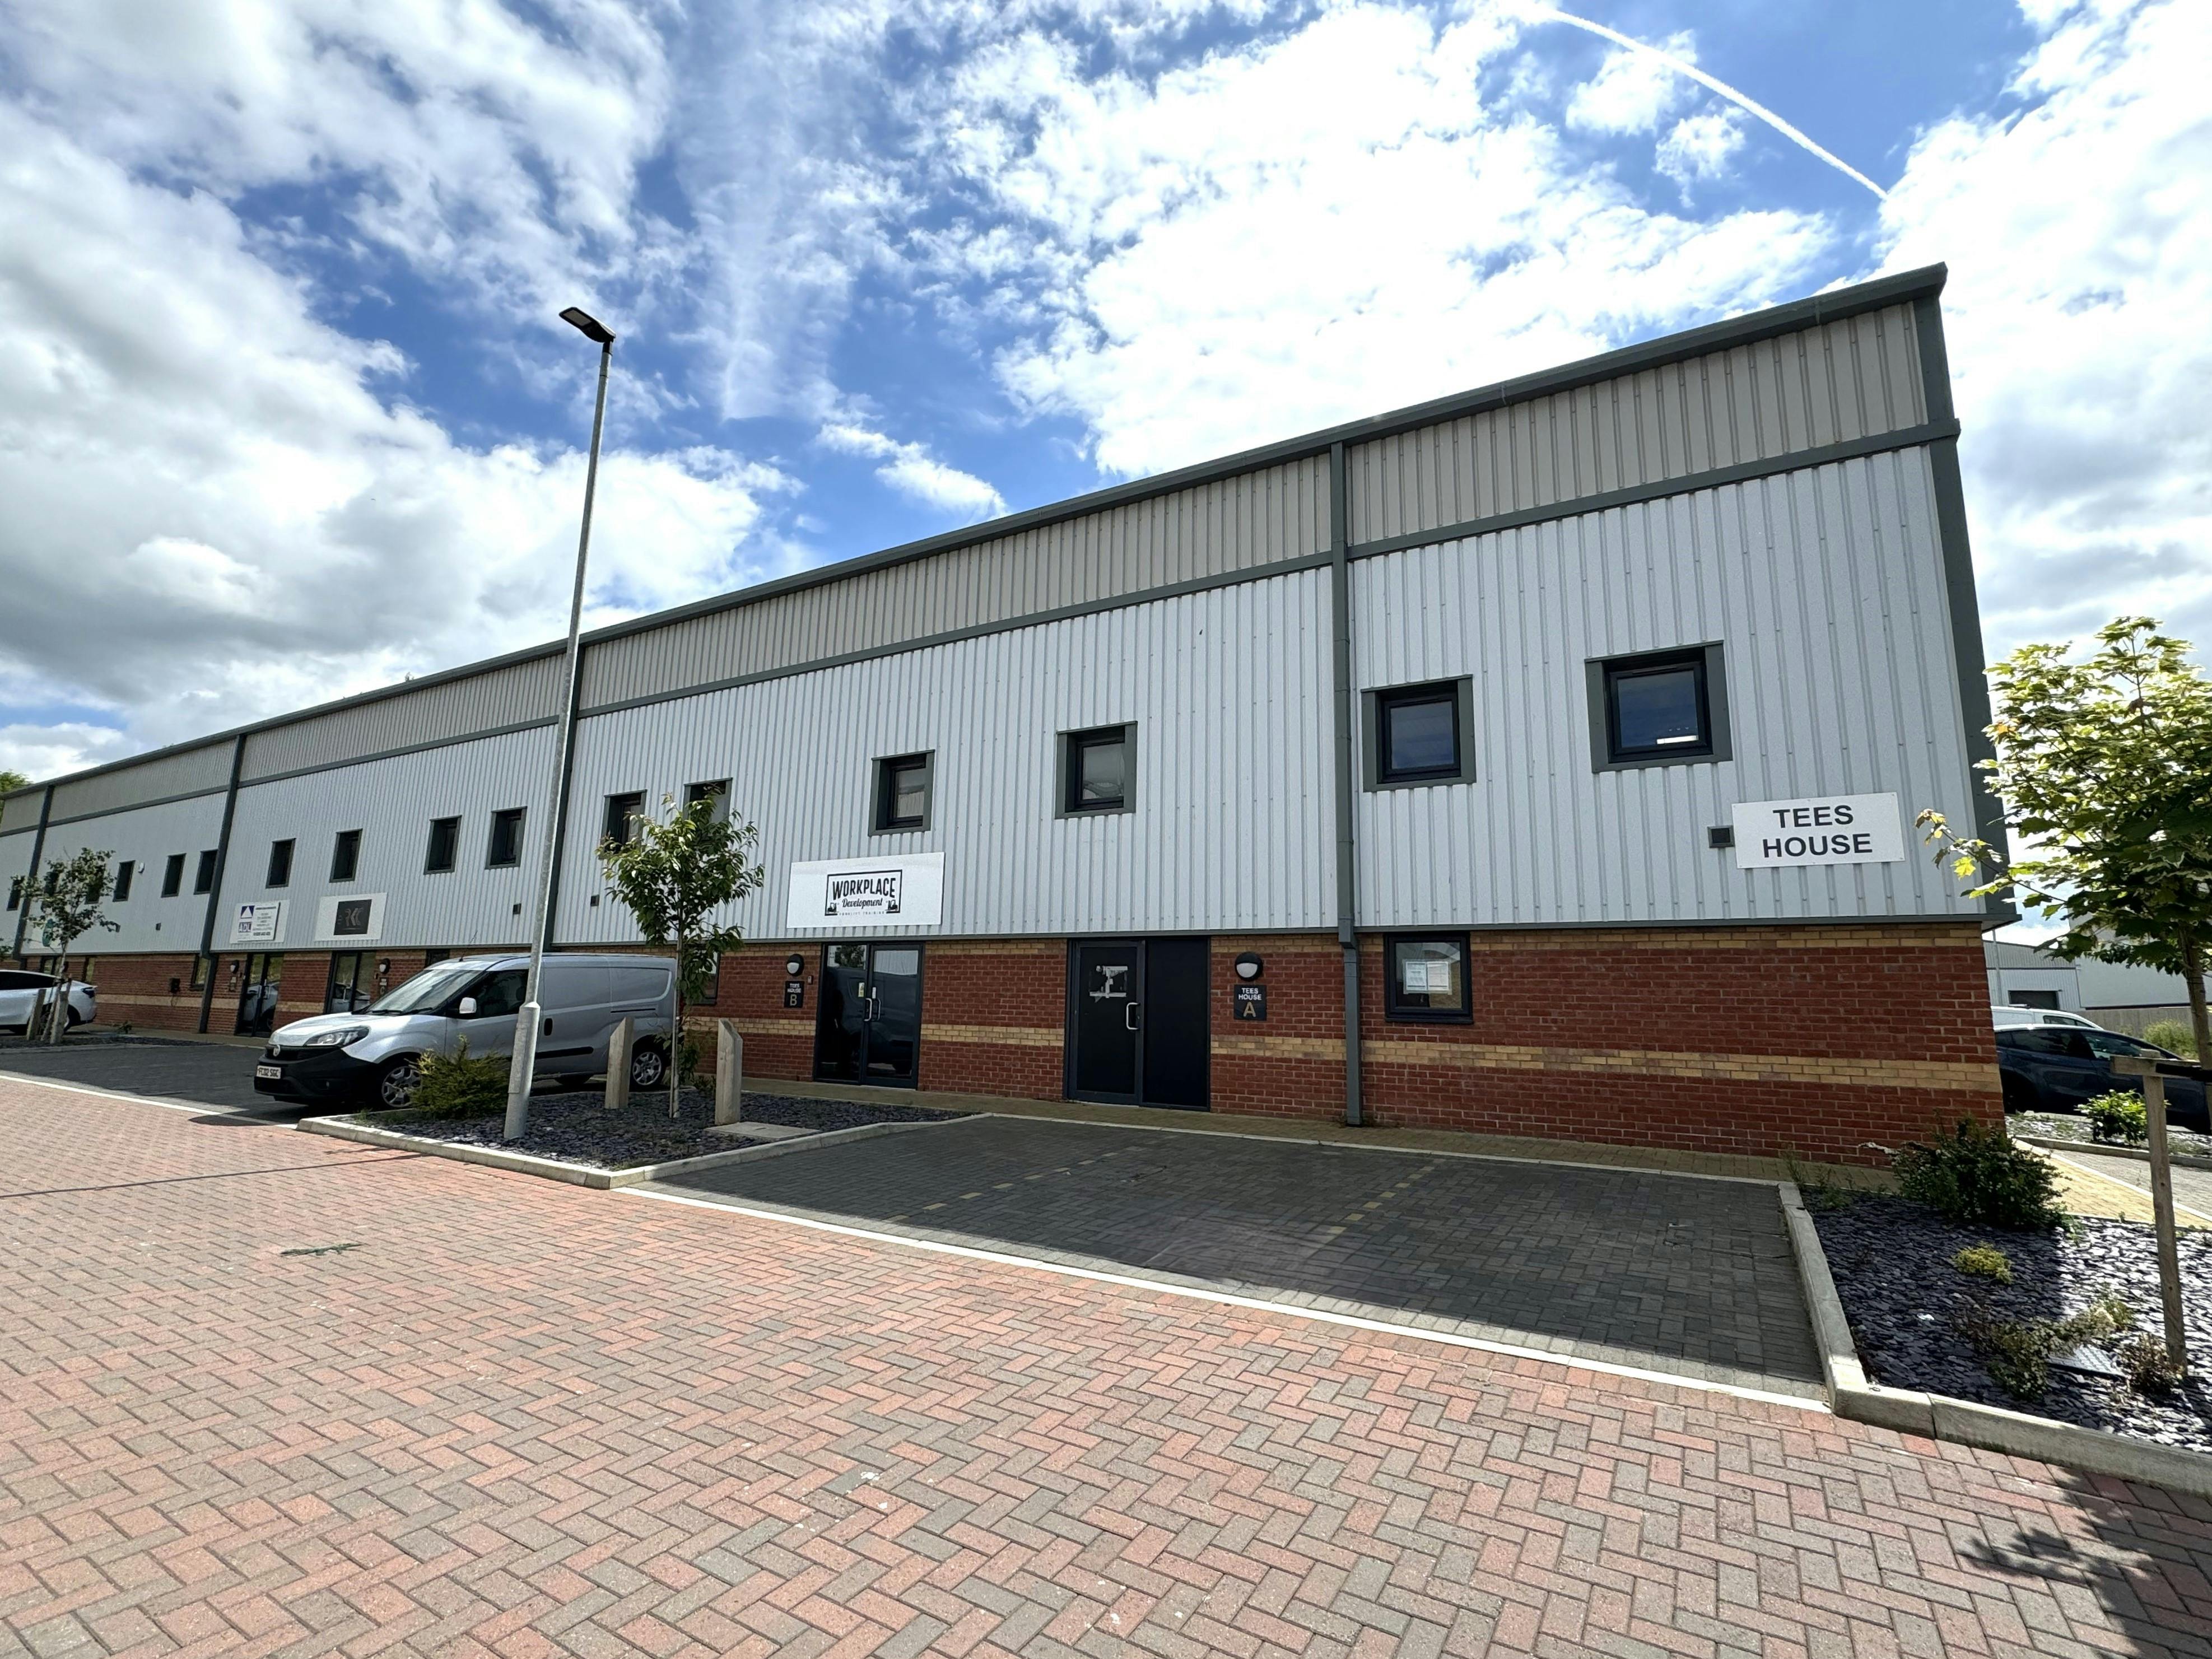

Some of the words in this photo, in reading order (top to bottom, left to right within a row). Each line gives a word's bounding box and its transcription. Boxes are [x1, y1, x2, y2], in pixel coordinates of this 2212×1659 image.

[1772, 805, 1854, 828] TEES
[1763, 833, 1873, 858] HOUSE
[832, 877, 896, 900] WORKPLACE
[842, 898, 883, 909] Development
[239, 923, 252, 932] ADL
[790, 994, 797, 1005] B
[1243, 1001, 1256, 1018] A
